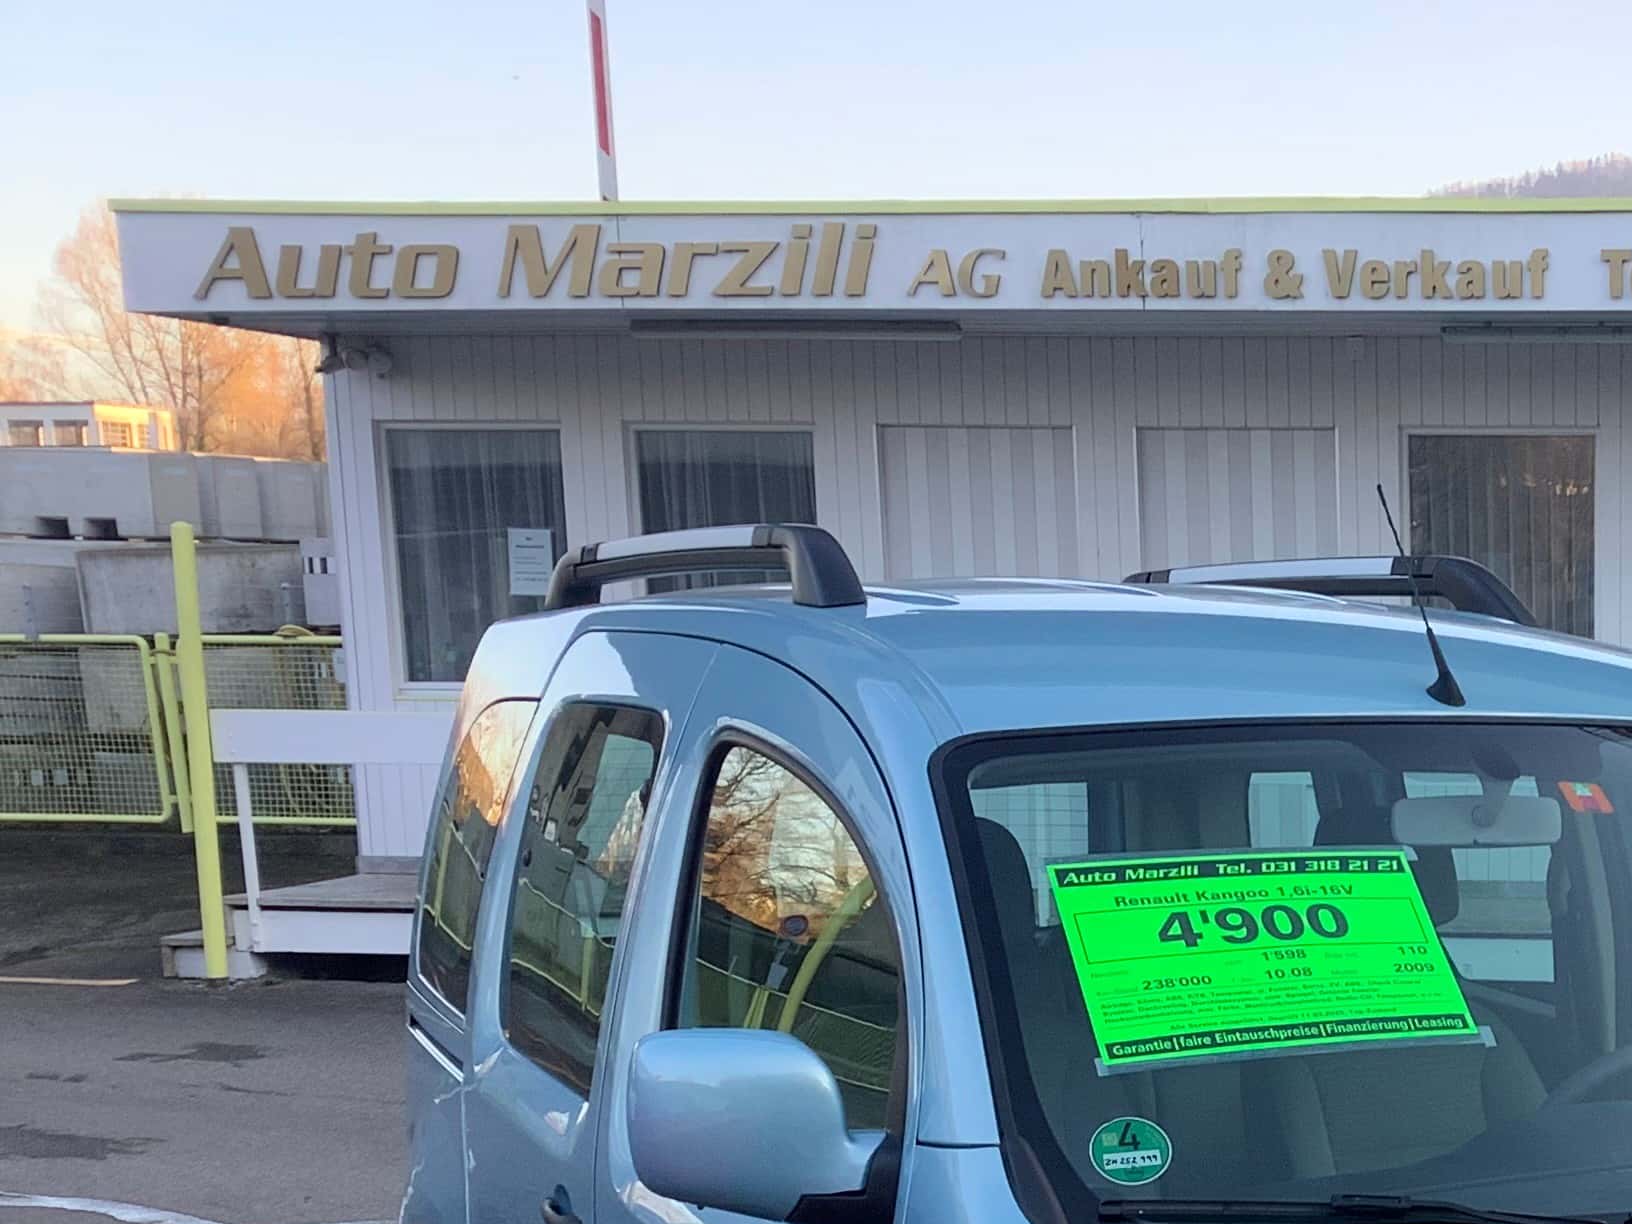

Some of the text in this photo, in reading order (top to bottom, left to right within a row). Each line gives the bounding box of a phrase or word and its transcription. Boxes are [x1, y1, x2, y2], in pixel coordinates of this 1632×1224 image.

[195, 226, 460, 299] Auto
[498, 221, 878, 298] Marzili
[906, 248, 1006, 298] AG
[1041, 248, 1243, 299] Ankauf
[1263, 249, 1304, 300] &
[1321, 248, 1549, 300] Verkauf
[1063, 859, 1398, 885] Auto Marzili Tel. 031 318 21 21
[1114, 892, 1190, 907] Renault
[1195, 888, 1269, 902] Kangoo
[1158, 903, 1349, 947] 4'900
[1397, 945, 1428, 957] 110
[1142, 975, 1213, 991] 238'000
[1393, 962, 1436, 974] 2009
[1118, 1121, 1141, 1150] 4
